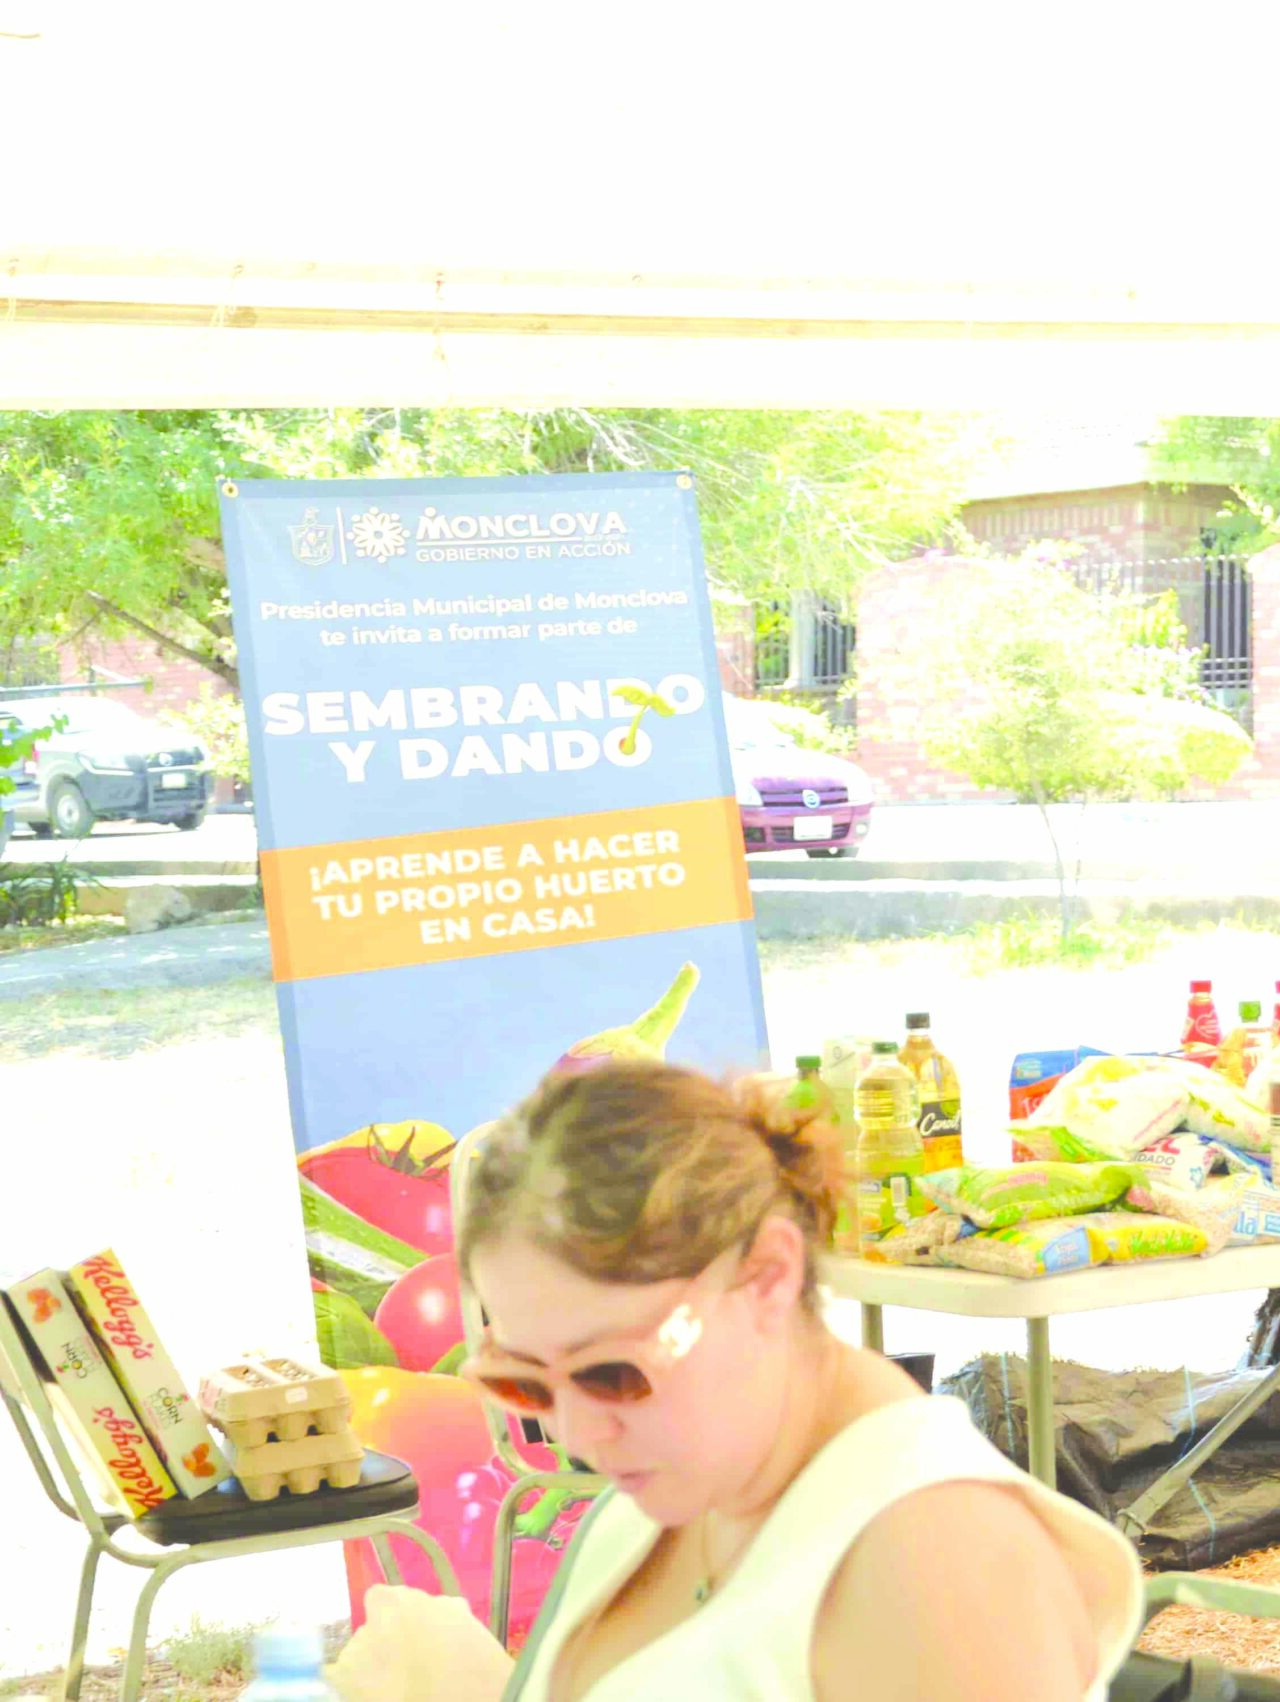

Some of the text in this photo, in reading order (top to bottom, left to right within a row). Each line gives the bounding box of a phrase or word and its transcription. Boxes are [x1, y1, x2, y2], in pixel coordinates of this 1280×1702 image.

[416, 507, 628, 541] MONCLOVA
[416, 540, 631, 562] GOBIERNO EN ACCIÓN
[260, 588, 688, 621] Presidencia Municipal de Monclova
[320, 616, 638, 647] te invita a formar parte de
[261, 674, 706, 736] SEMBRANDO
[328, 726, 653, 783] Y DANDO
[309, 830, 681, 892] ¡APRENDE A HACER
[312, 862, 687, 920] TU PROPIO HUERTO
[419, 905, 598, 946] EN CASA!
[79, 1255, 154, 1361] Kellogg's
[157, 1386, 183, 1425] CORN
[93, 1406, 165, 1509] Kellogg's
